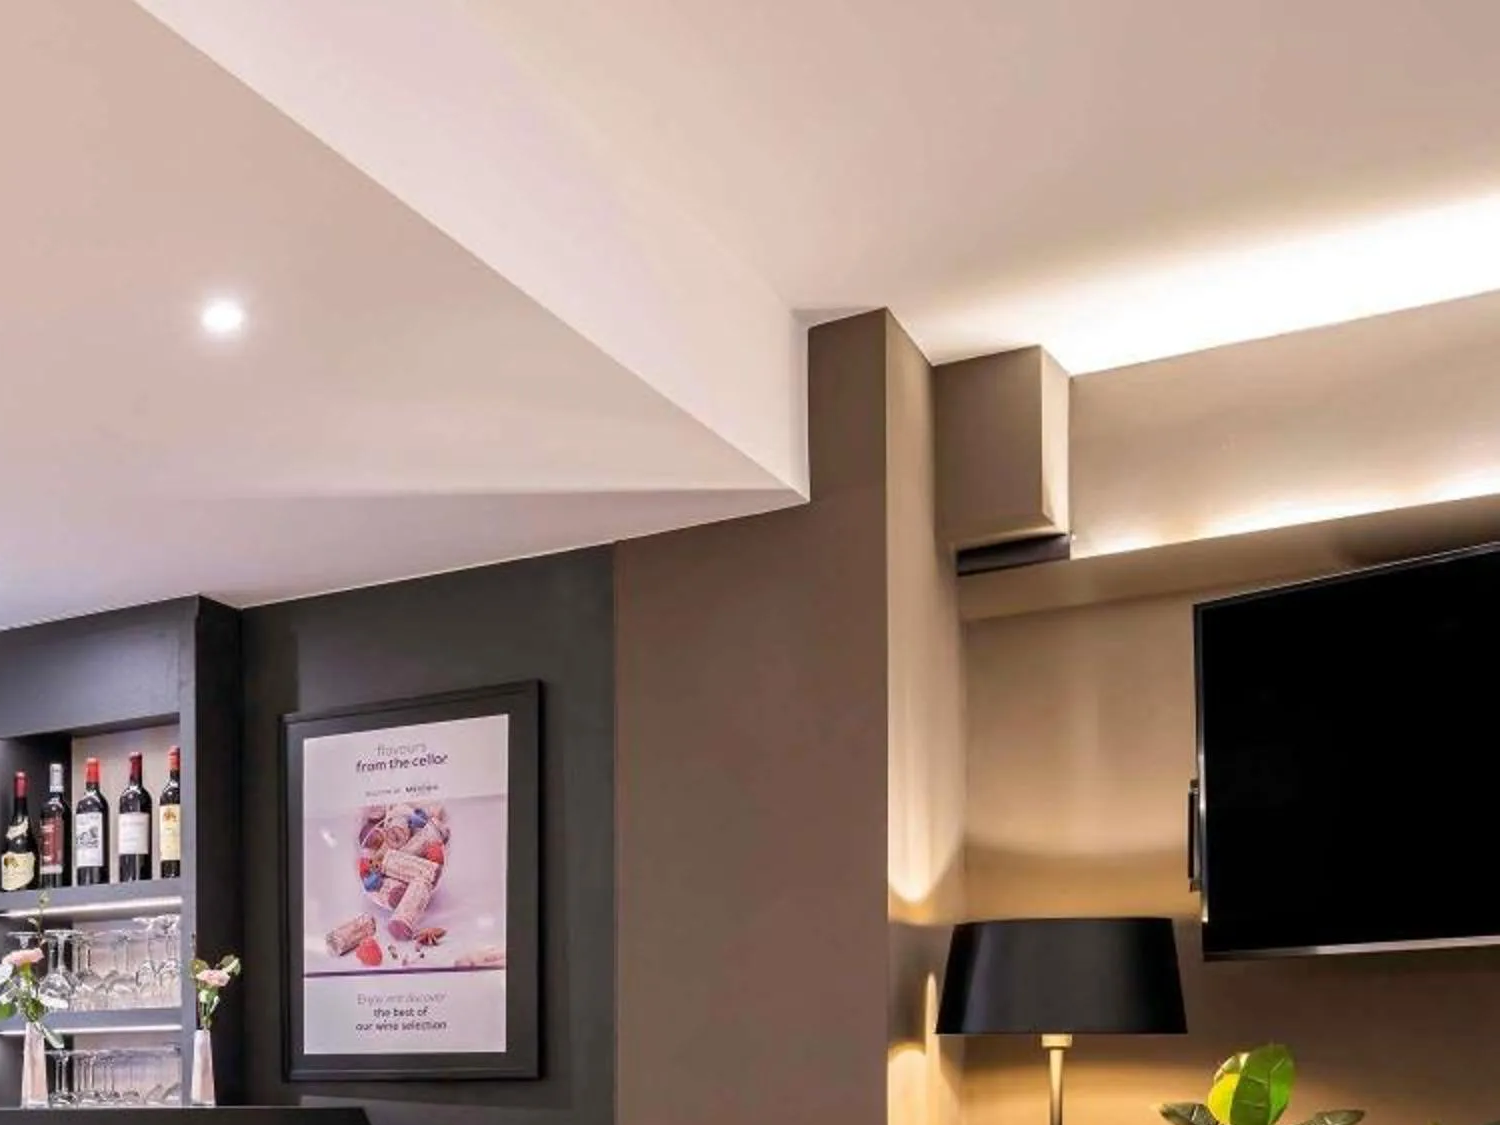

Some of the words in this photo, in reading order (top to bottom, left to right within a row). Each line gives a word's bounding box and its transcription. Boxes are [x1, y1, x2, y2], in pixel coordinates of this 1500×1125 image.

[375, 743, 427, 757] flavours
[356, 759, 387, 773] from
[389, 757, 410, 769] the
[411, 752, 449, 767] cellar
[373, 1007, 391, 1018] the
[393, 1007, 415, 1017] best
[416, 1006, 429, 1017] of
[355, 1022, 373, 1031] our
[375, 1019, 399, 1031] wine
[401, 1020, 447, 1031] selection
